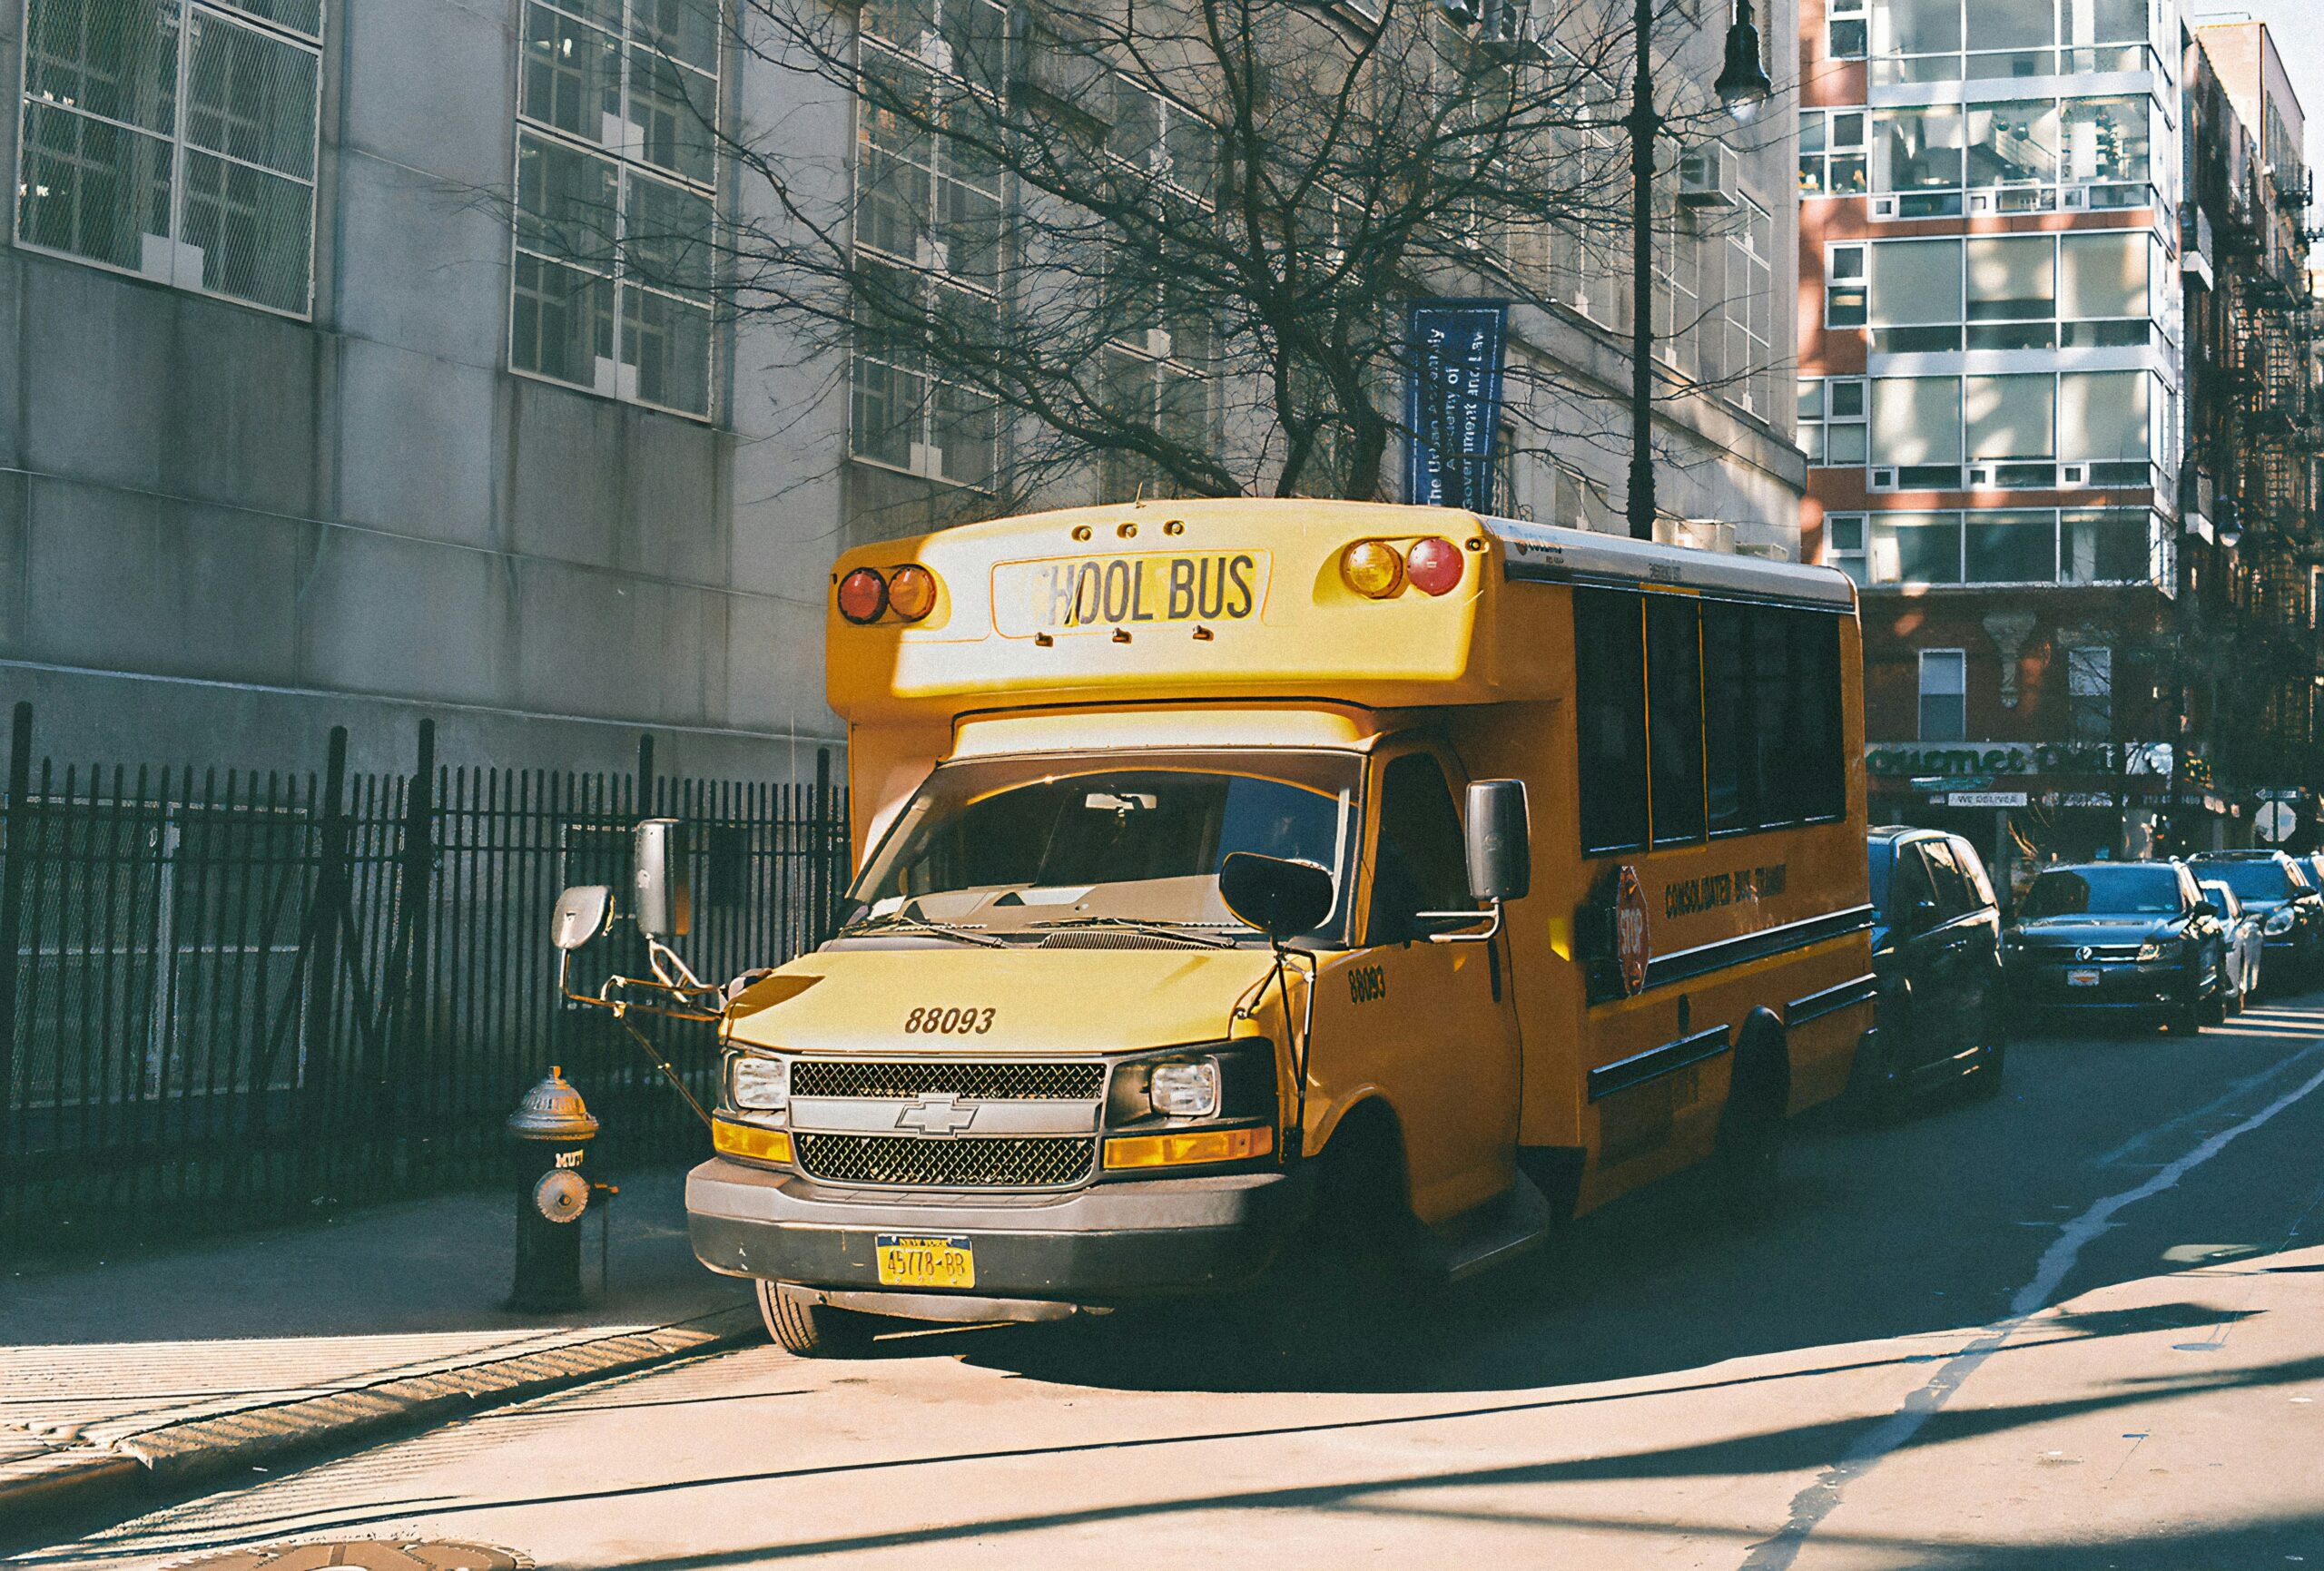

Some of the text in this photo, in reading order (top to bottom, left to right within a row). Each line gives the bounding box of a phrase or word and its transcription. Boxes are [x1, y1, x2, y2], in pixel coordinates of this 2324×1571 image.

[1468, 330, 1484, 362] Law
[1445, 366, 1460, 385] of
[1035, 554, 1255, 626] HOOL BUS
[1866, 750, 2026, 774] ourmet
[1348, 965, 1386, 1004] 88093
[905, 1006, 997, 1035] 88093
